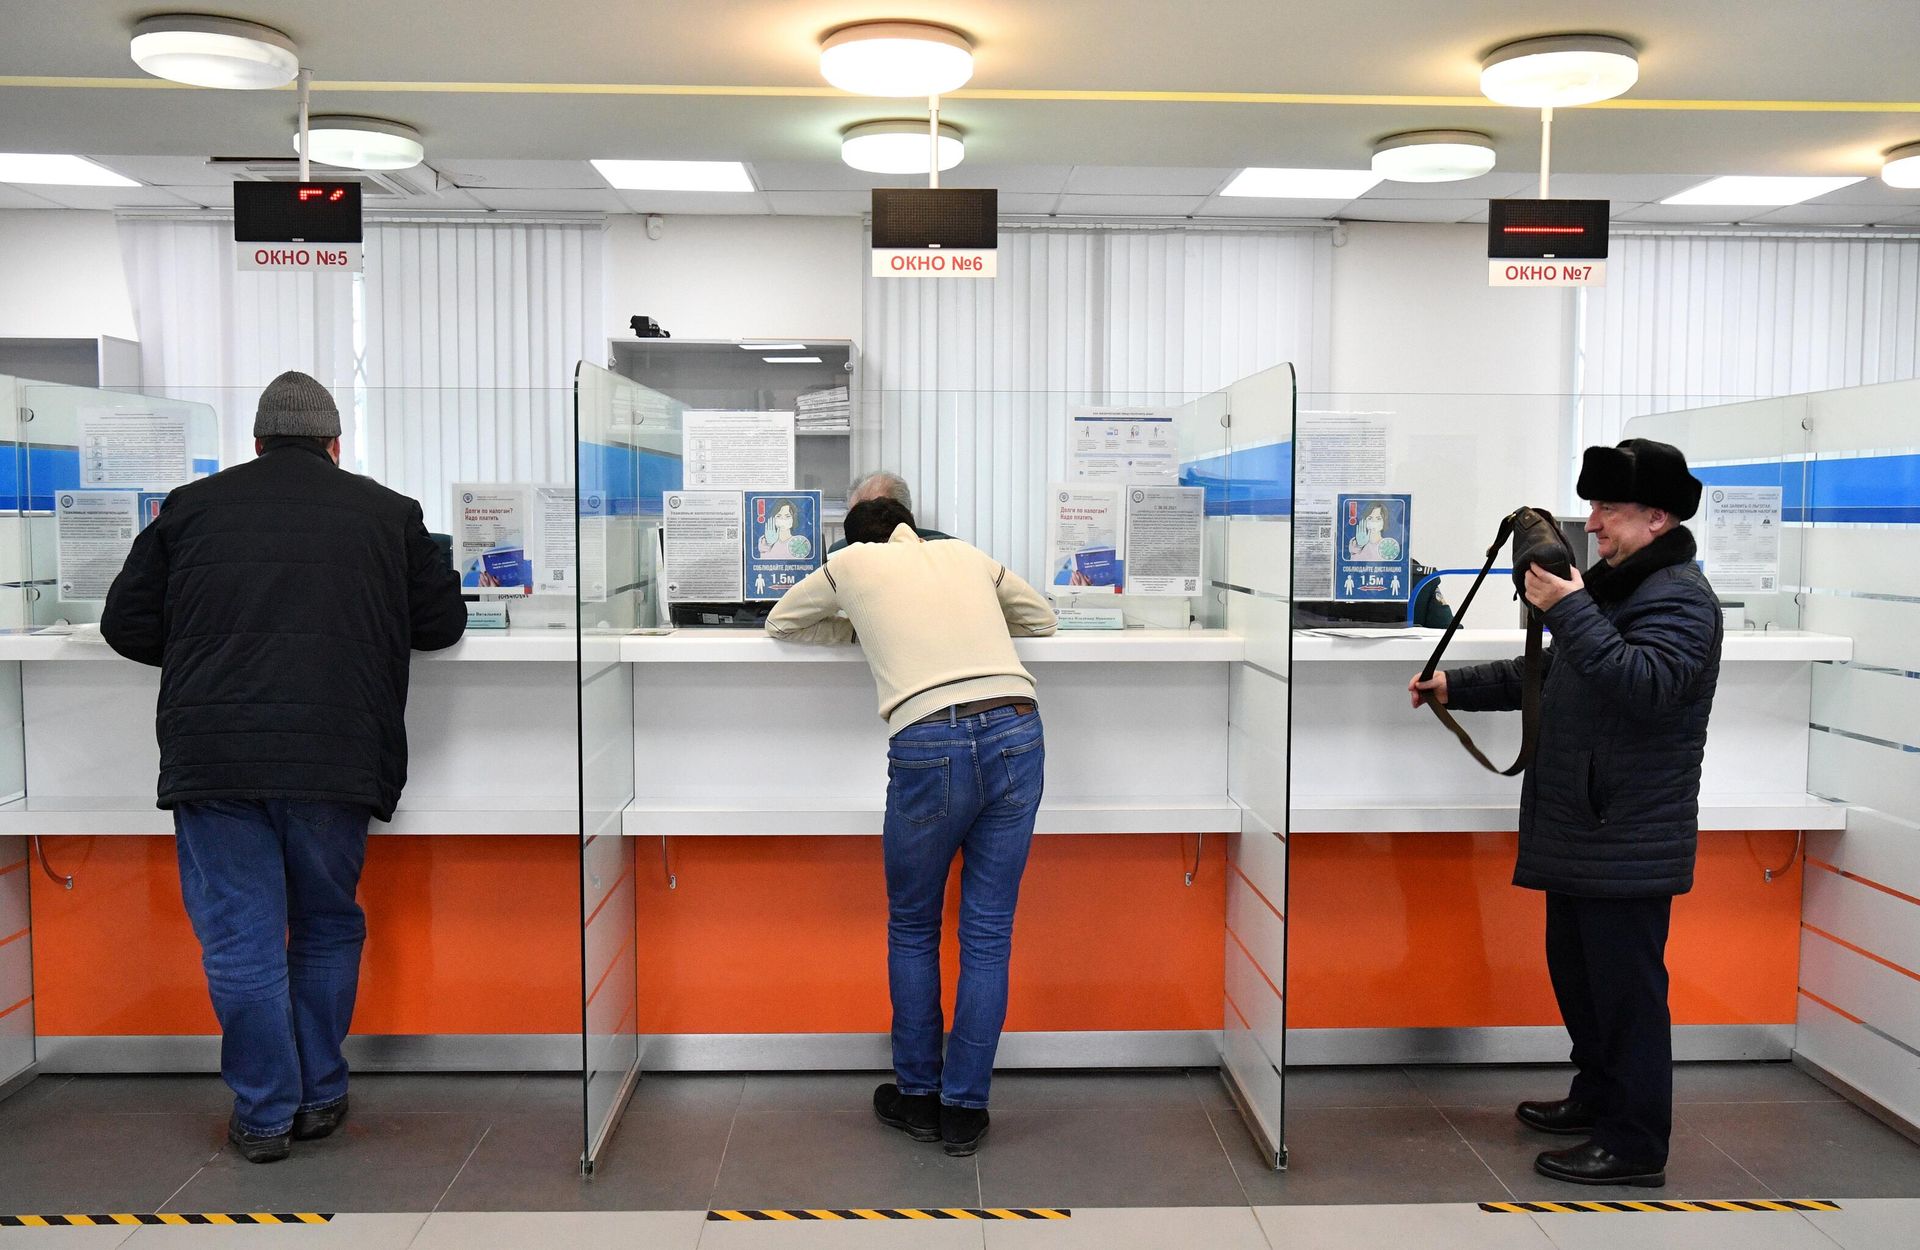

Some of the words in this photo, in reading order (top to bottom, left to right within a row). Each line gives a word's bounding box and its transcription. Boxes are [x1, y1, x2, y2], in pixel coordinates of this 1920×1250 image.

[255, 249, 310, 265] ОКНО
[316, 250, 348, 266] №5
[890, 256, 945, 270] ОКНО
[952, 256, 982, 271] №6
[1505, 266, 1556, 280] ОКНО
[1563, 266, 1592, 280] №7
